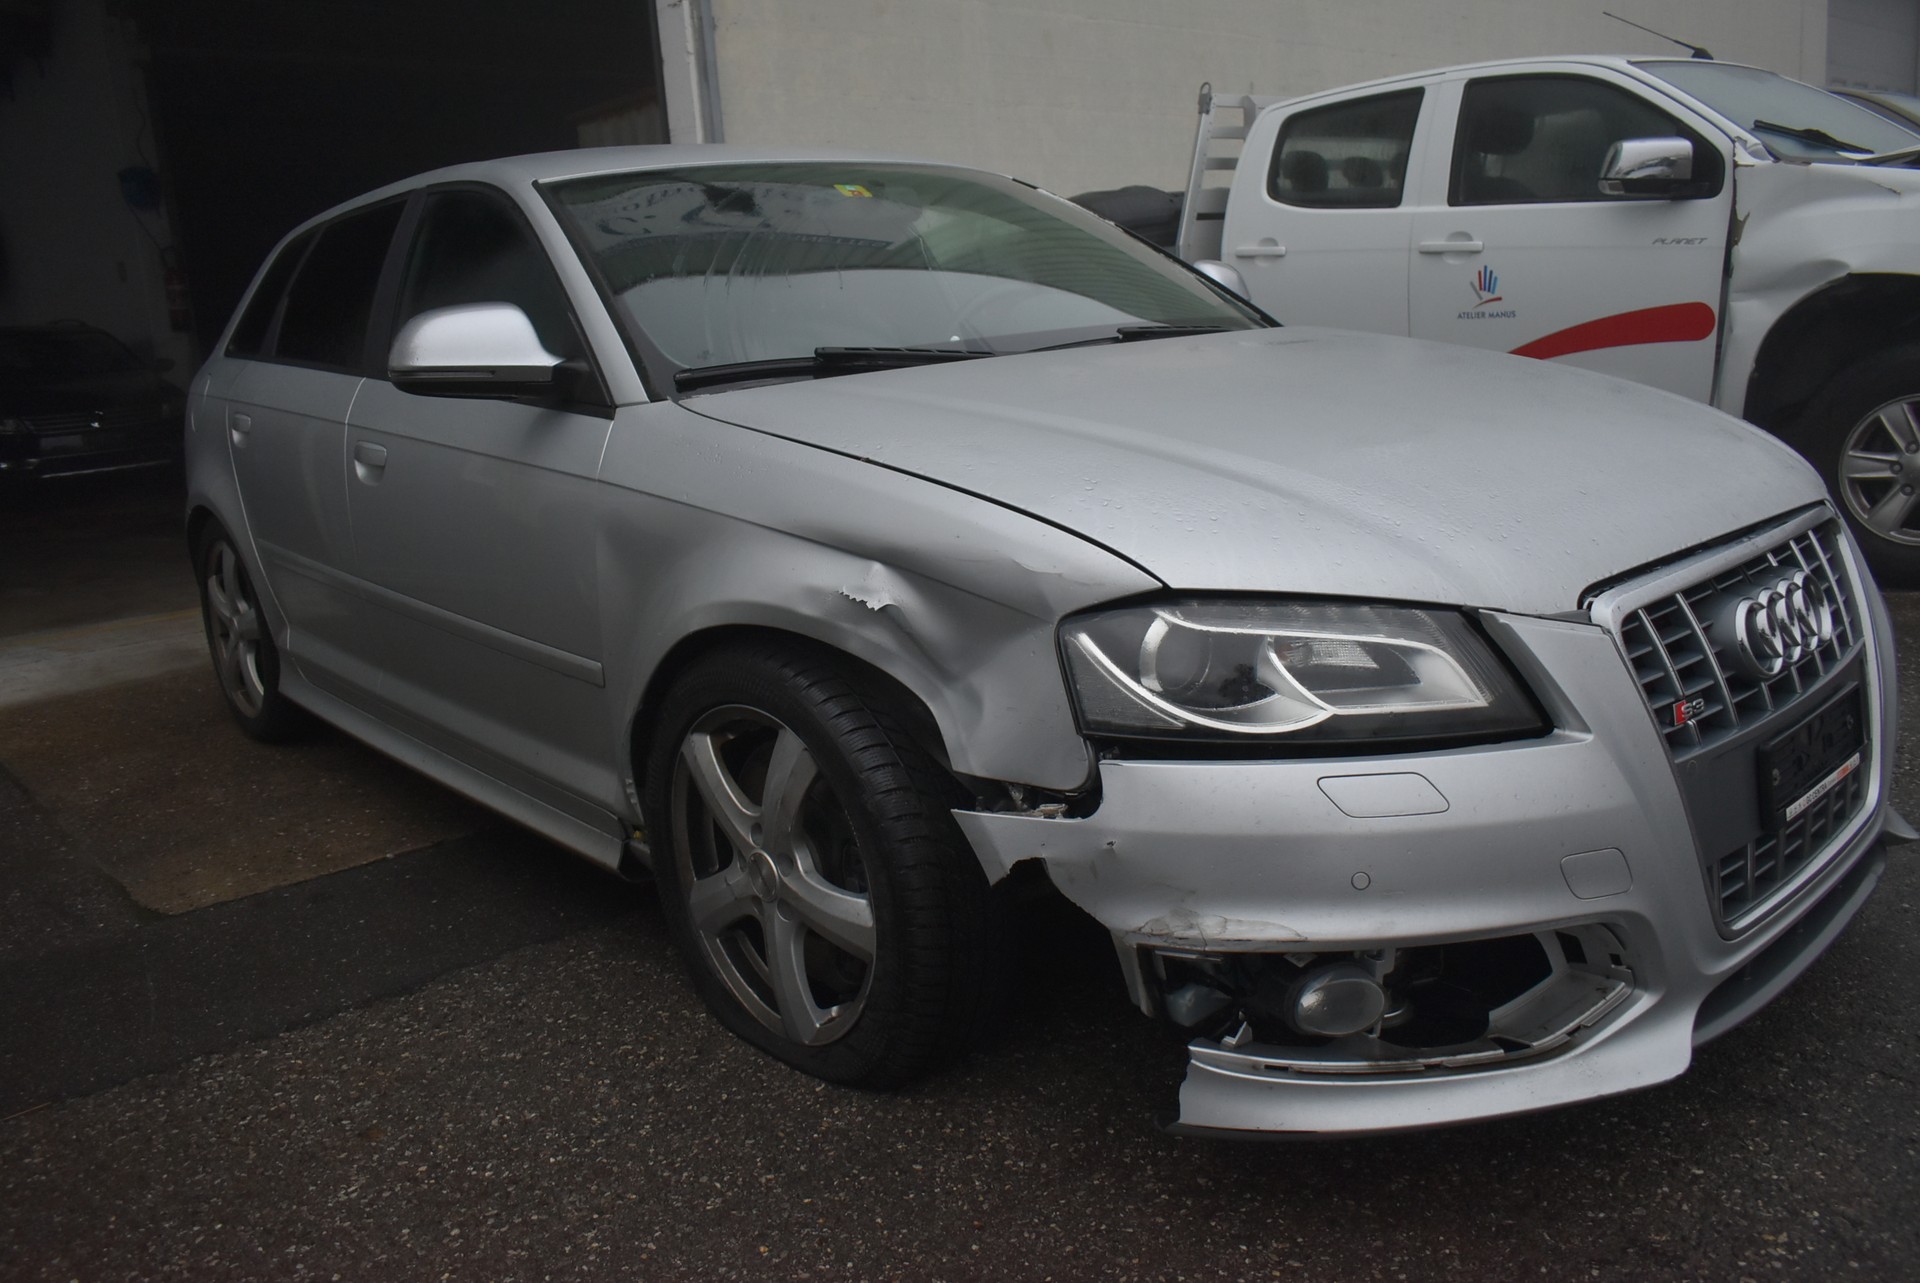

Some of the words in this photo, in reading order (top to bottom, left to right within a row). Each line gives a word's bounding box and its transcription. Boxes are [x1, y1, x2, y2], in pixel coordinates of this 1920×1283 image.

[1652, 237, 1709, 245] PLANET
[1456, 311, 1486, 320] ATELIER
[1488, 310, 1517, 319] MANUS
[1681, 698, 1705, 719] S3
